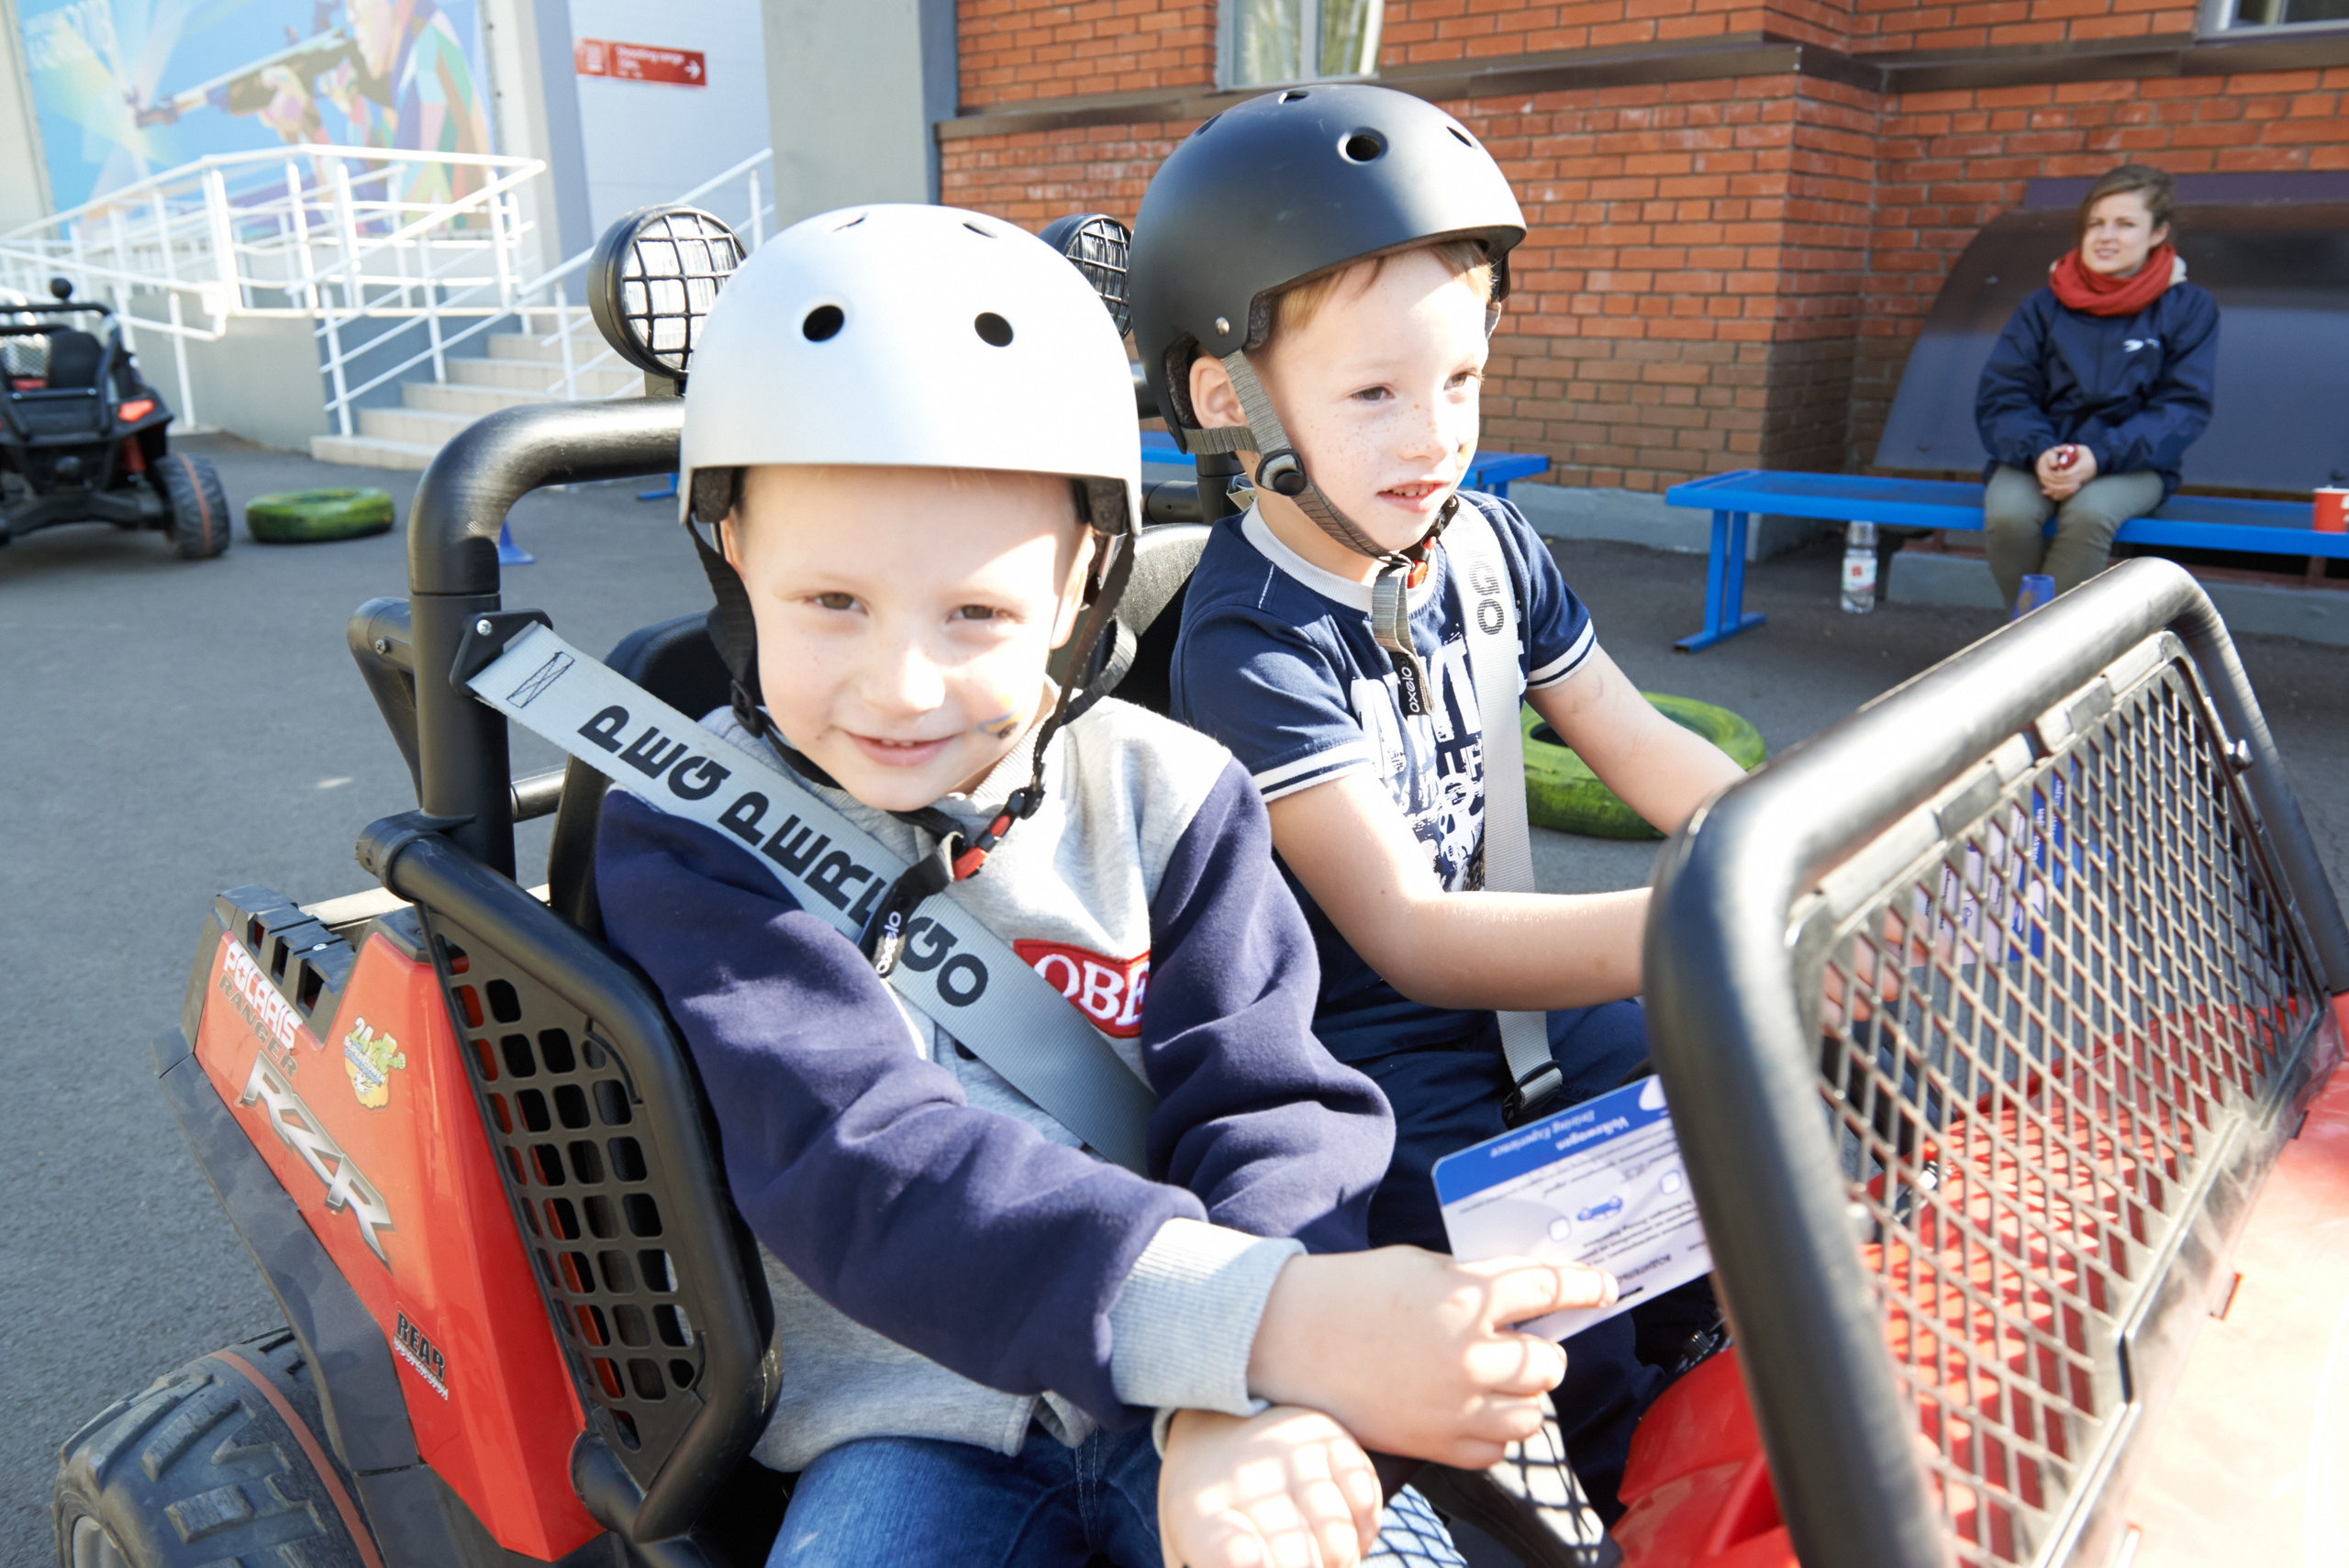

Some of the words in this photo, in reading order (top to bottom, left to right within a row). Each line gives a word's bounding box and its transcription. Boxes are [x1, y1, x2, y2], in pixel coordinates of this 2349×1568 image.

[1401, 666, 1420, 713] oxelo
[577, 705, 732, 801] PEG
[875, 911, 902, 973] oxelo
[217, 973, 297, 1078] RANGER
[223, 940, 303, 1050] POLARIS
[242, 1049, 395, 1275] RZR
[1555, 1116, 1630, 1151] Volkswagen
[396, 1309, 445, 1382] REAR
